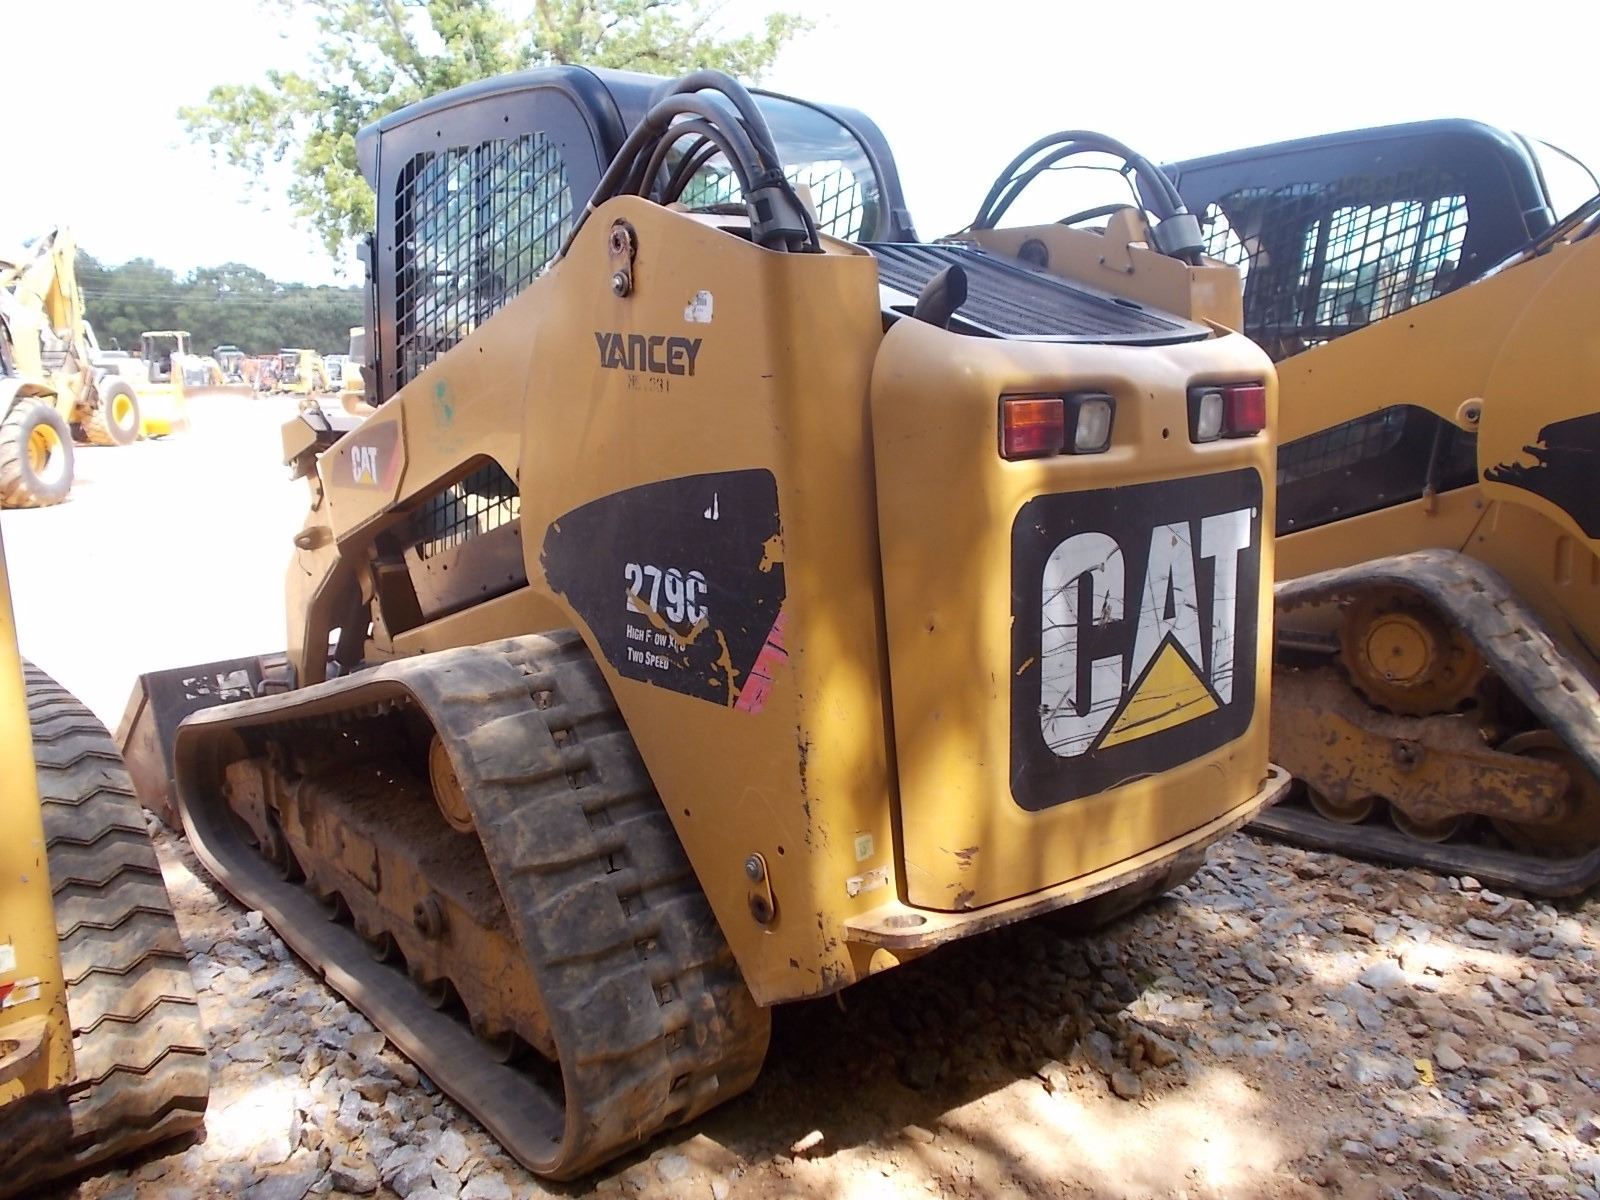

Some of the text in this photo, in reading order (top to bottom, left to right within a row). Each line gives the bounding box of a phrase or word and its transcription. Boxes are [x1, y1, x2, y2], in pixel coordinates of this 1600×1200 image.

[595, 332, 702, 376] YANCEY
[351, 445, 377, 484] CAT
[624, 563, 708, 626] 279C
[645, 630, 667, 647] FOW
[1041, 508, 1251, 757] CAT
